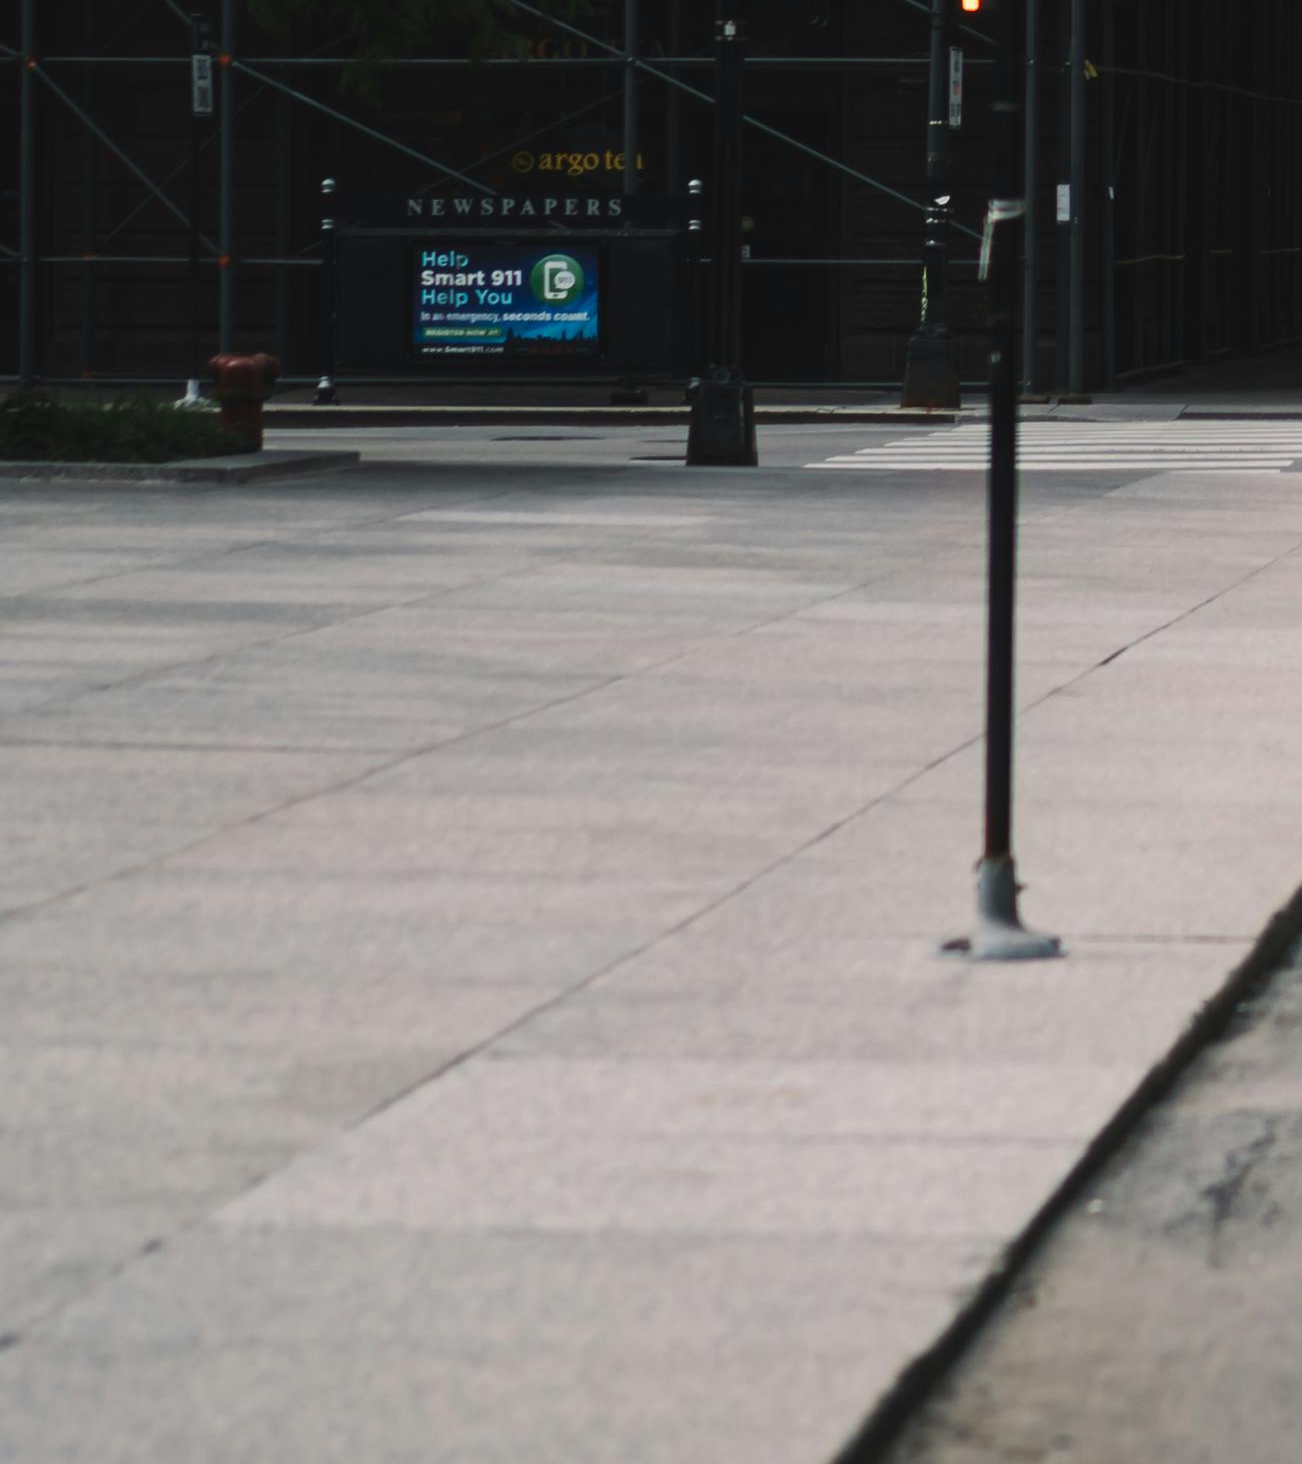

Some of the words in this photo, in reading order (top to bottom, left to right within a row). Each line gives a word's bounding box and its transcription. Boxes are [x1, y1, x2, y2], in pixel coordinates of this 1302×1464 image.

[538, 153, 600, 175] argo
[406, 198, 623, 216] NEWSPAPERS
[421, 251, 469, 269] Help
[421, 270, 486, 286] Smart
[491, 270, 523, 286] 911
[421, 289, 469, 307] Help
[476, 289, 513, 305] You
[502, 311, 552, 321] seconds
